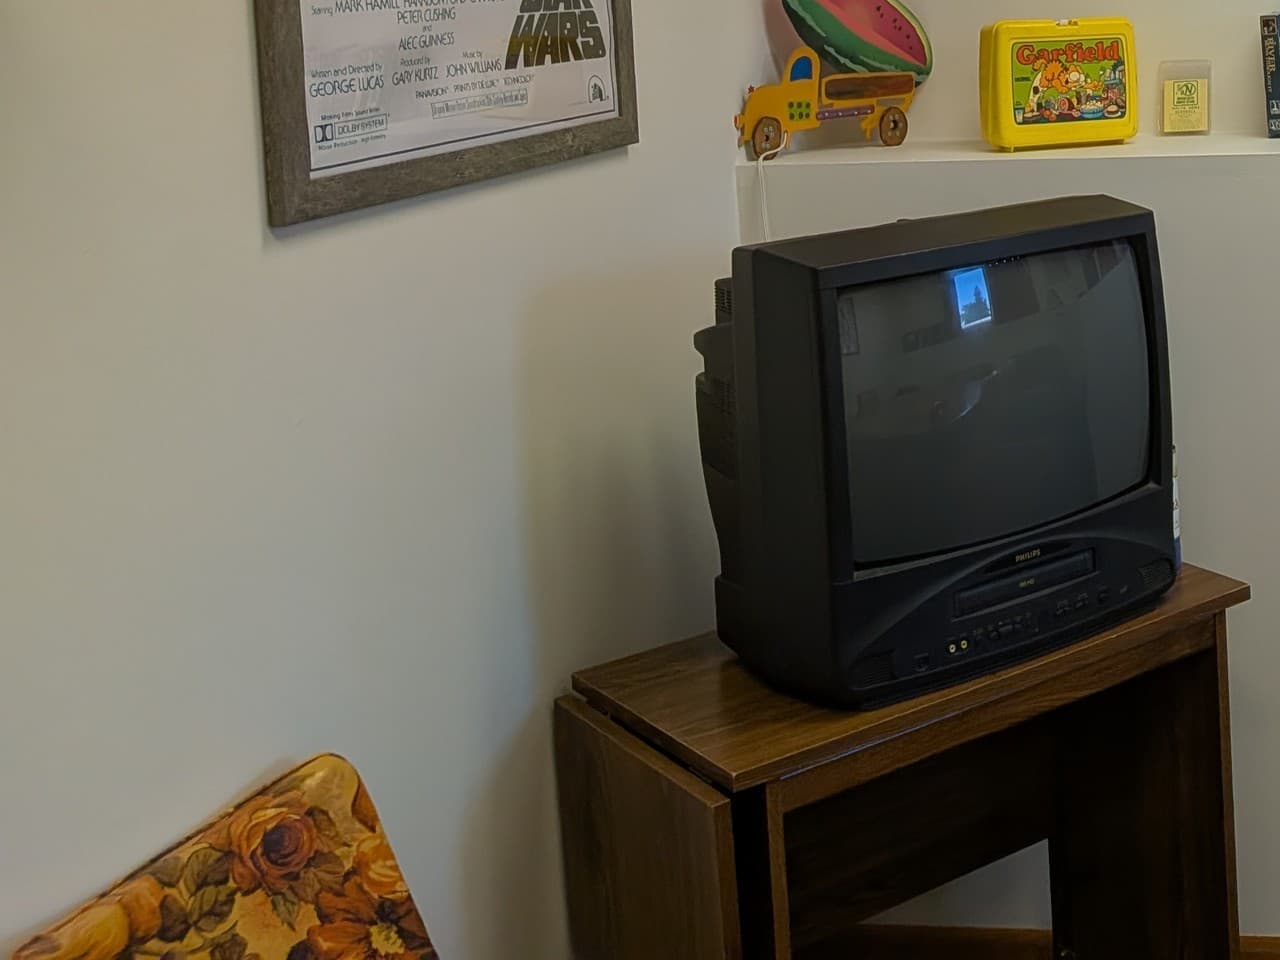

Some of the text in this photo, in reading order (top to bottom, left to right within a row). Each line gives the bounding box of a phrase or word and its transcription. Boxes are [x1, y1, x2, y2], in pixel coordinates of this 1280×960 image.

[396, 7, 457, 25] PETER CUSHING
[398, 32, 455, 51] ALEC GUINNESS
[504, 10, 607, 70] WARS
[1016, 40, 1120, 65] Garfield
[391, 66, 439, 86] GARY KURTZ
[446, 58, 502, 78] JOHN WILLIAMS
[310, 74, 384, 97] GEORGE LUCAS
[337, 119, 384, 135] DOLBY SYSTEM
[1015, 548, 1041, 563] PHILIPS
